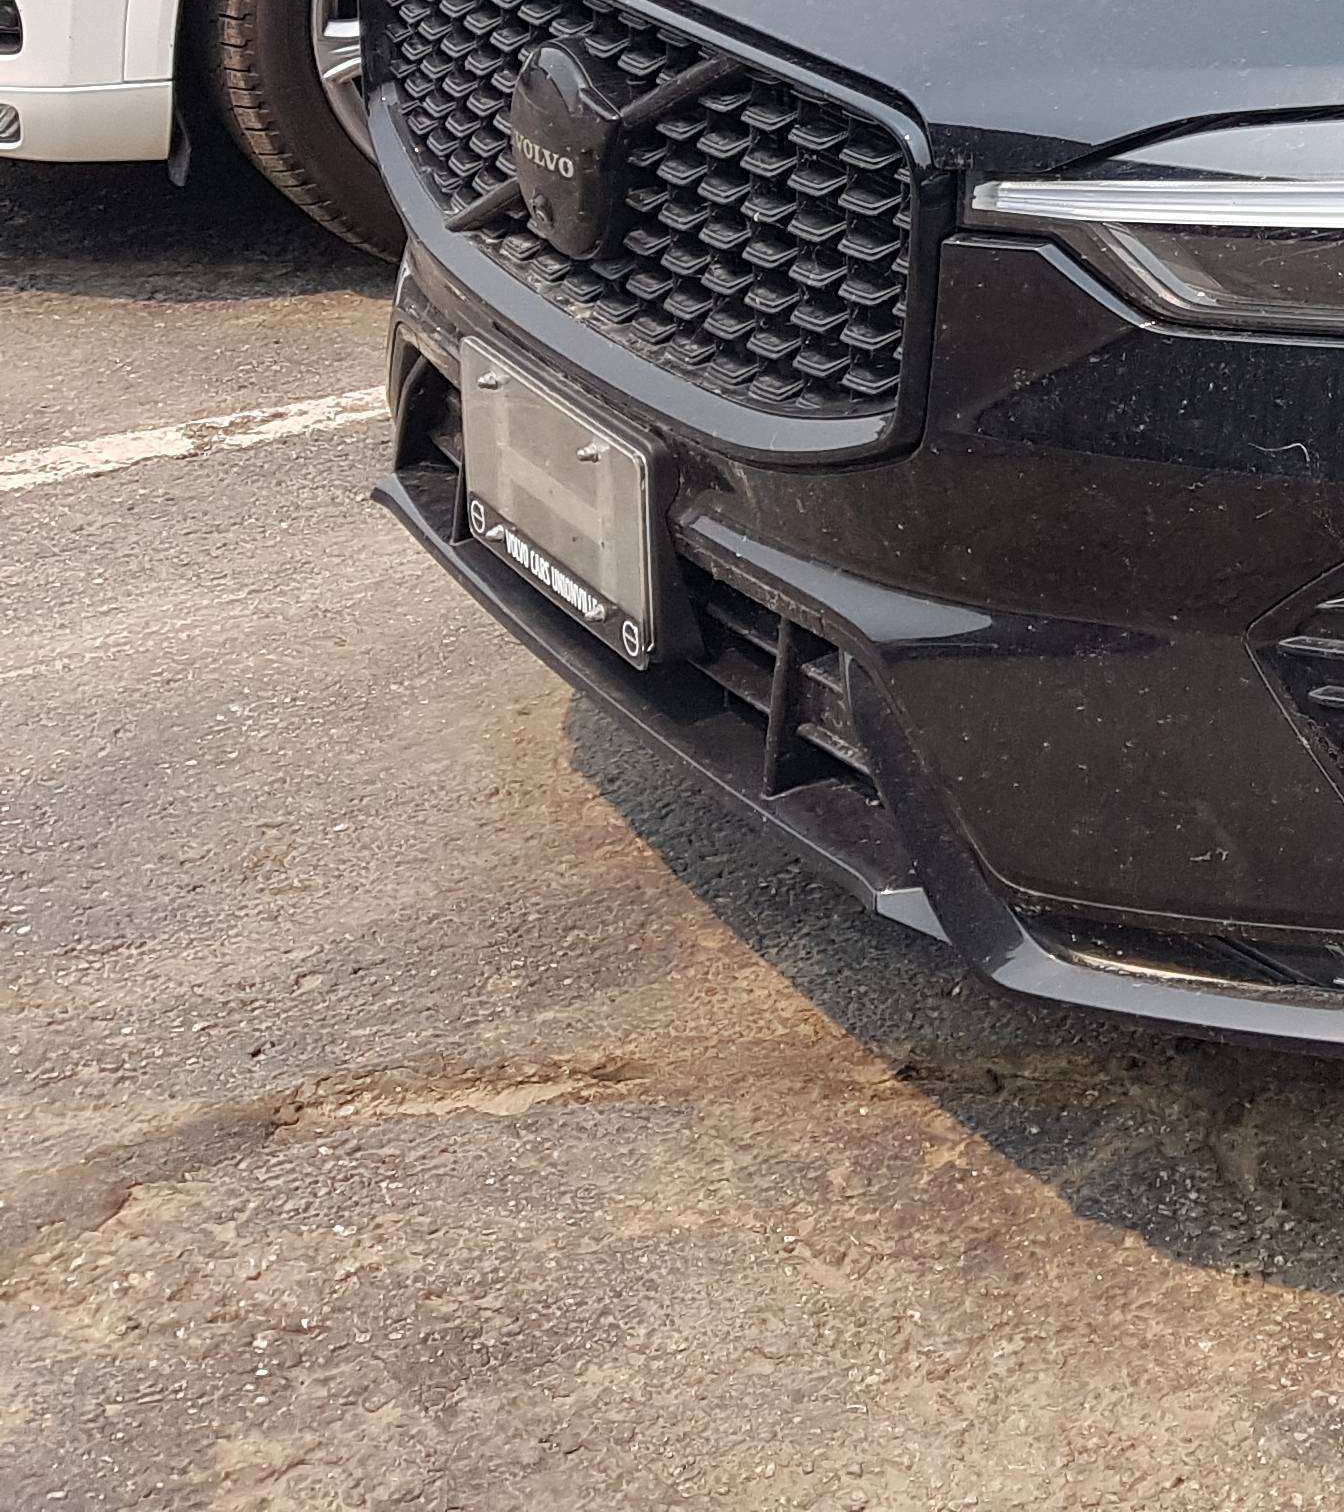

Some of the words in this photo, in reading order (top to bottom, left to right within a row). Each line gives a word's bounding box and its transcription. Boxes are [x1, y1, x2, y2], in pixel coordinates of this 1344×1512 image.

[514, 130, 574, 178] VOLVO
[504, 528, 529, 569] VOLVO
[530, 550, 551, 586] CARS
